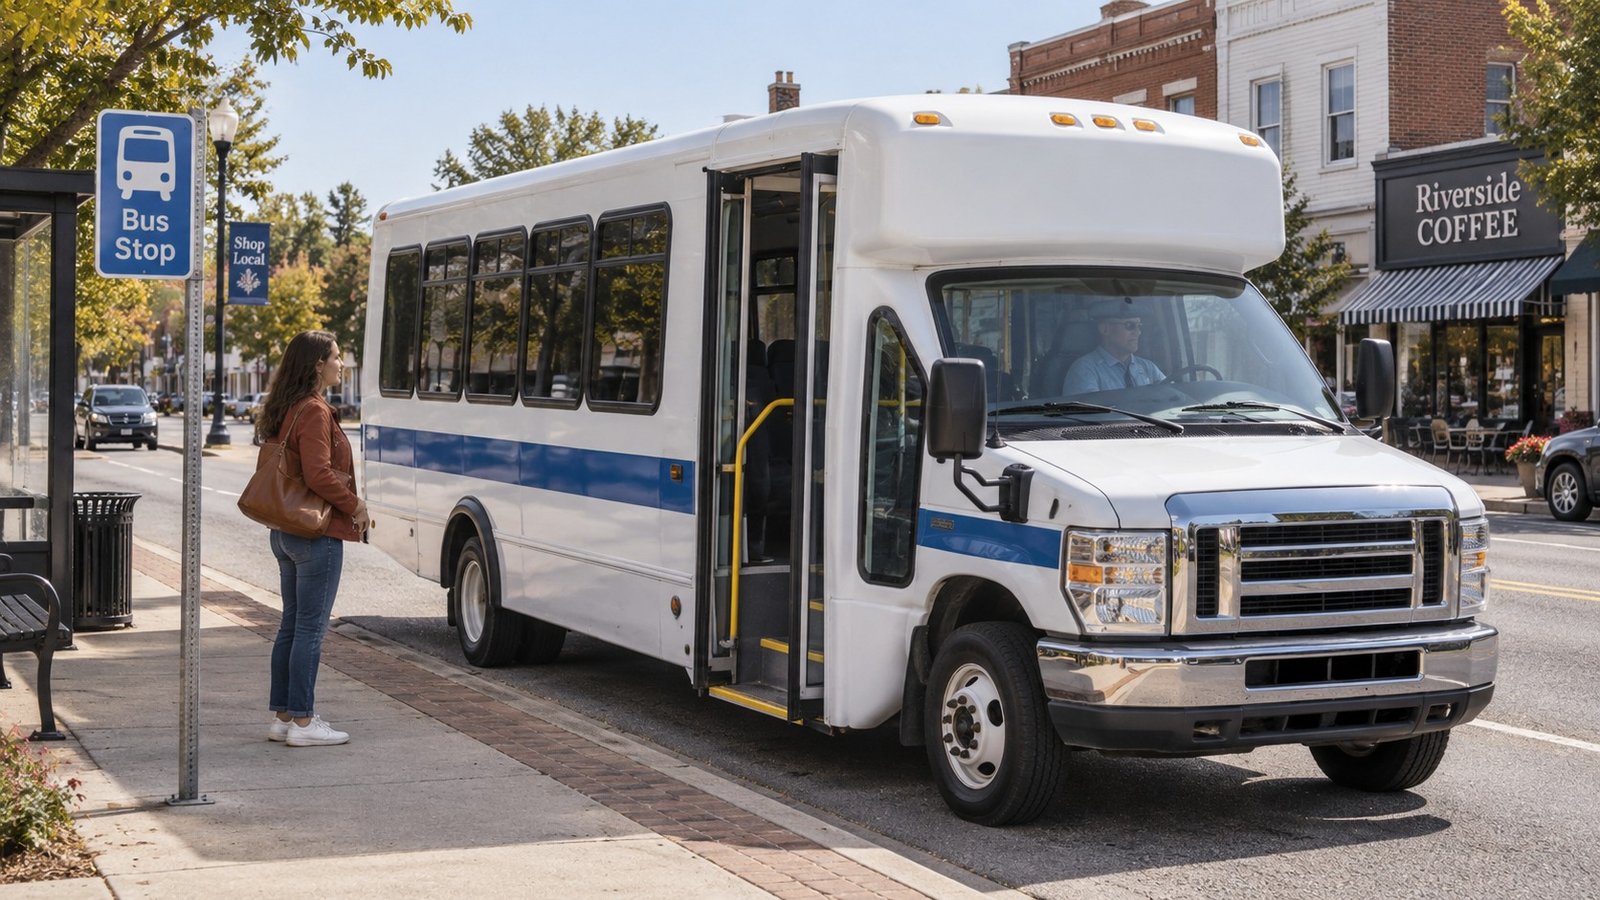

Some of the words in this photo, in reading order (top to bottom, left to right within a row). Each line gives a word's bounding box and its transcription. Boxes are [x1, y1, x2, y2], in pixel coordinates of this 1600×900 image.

[1416, 171, 1521, 213] Riverside
[122, 208, 169, 231] Bus
[1417, 209, 1518, 246] COFFEE
[115, 237, 174, 266] Stop
[234, 236, 265, 252] Shop
[233, 252, 265, 265] Local
